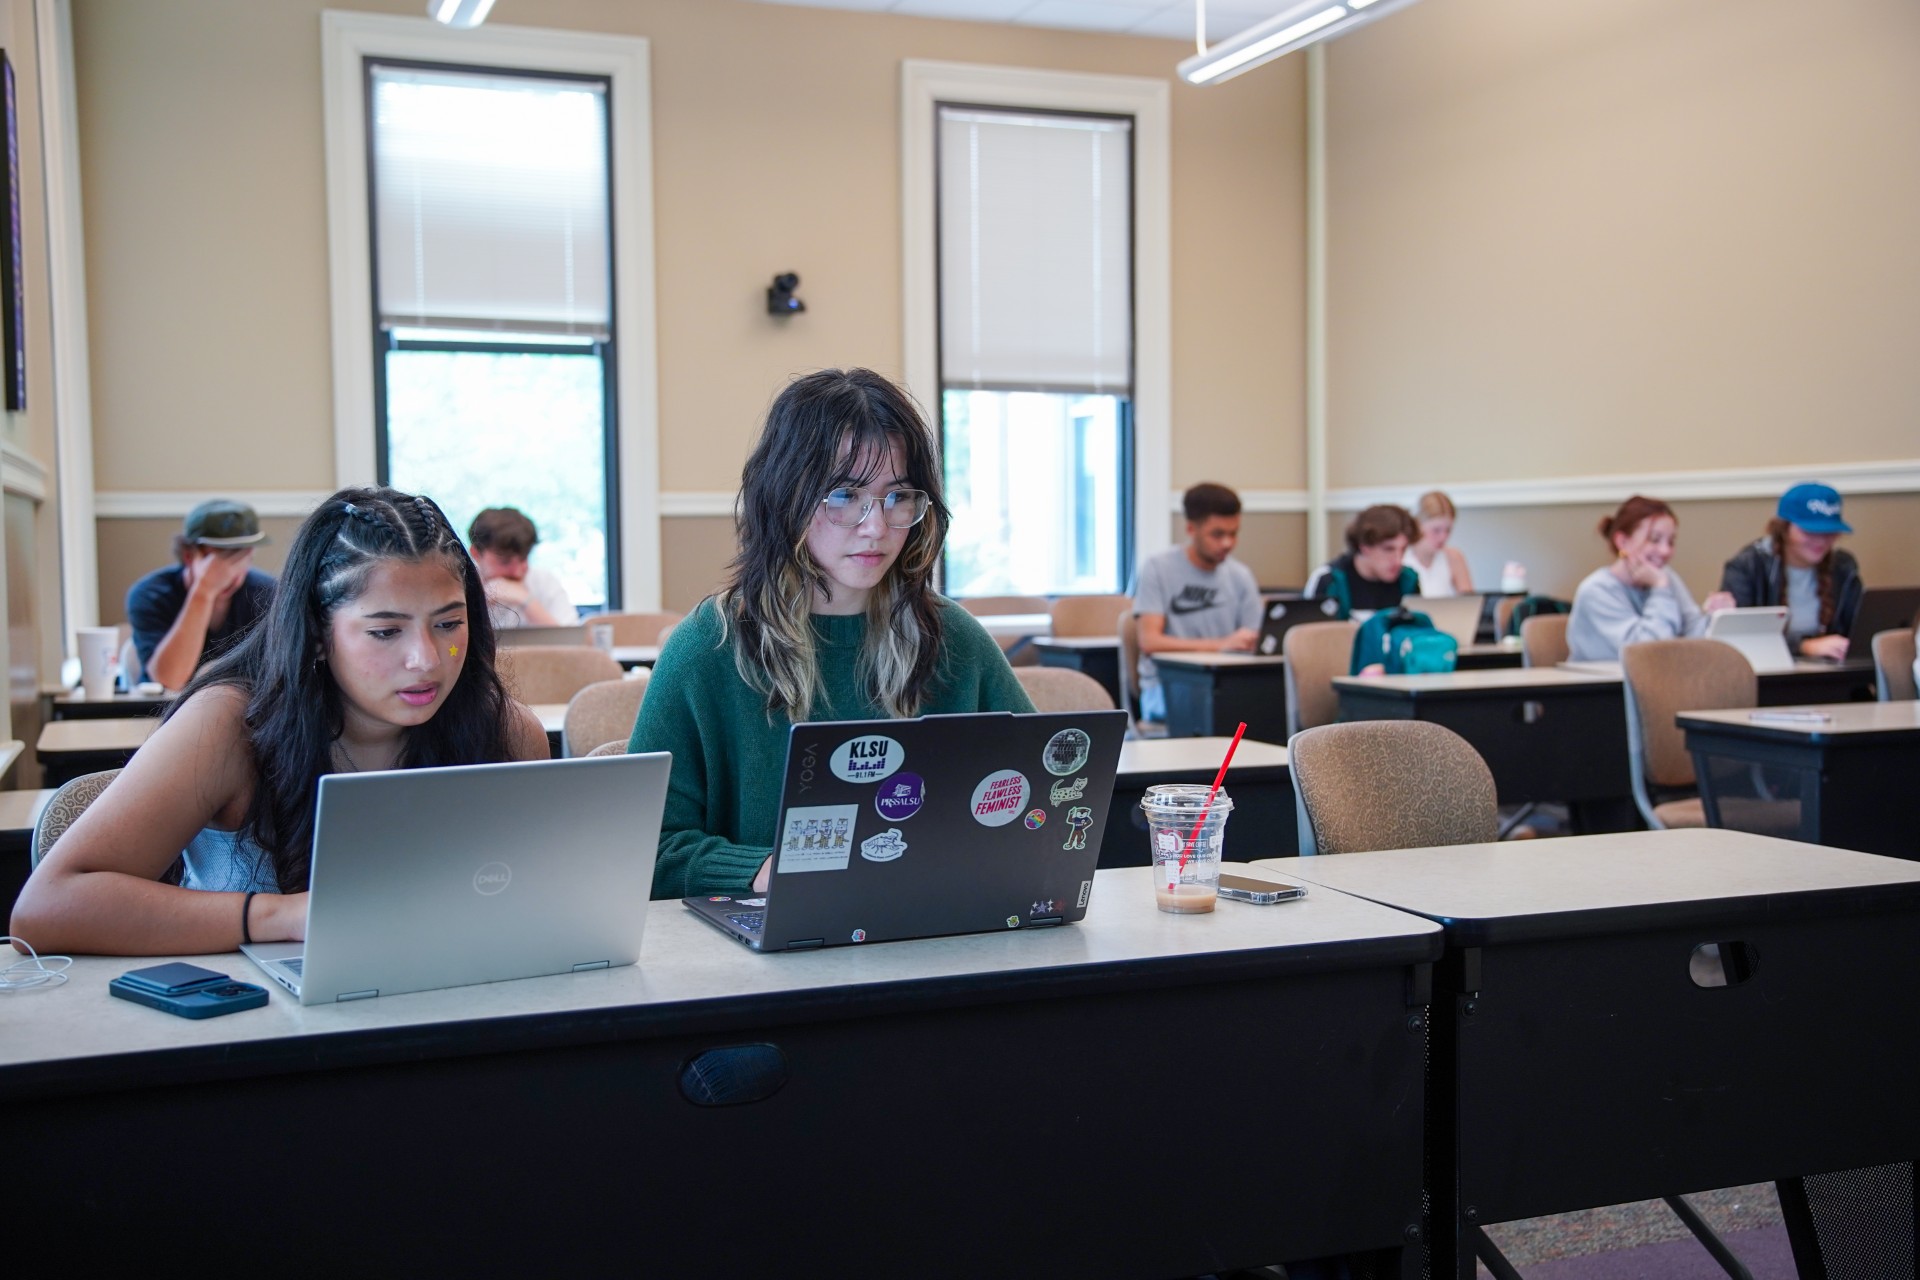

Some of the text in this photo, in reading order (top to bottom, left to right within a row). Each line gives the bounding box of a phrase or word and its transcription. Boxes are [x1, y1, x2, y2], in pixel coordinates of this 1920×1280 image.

[849, 740, 889, 759] KLSU
[799, 743, 818, 794] YOGA
[990, 775, 1022, 790] FEARLESS
[983, 785, 1023, 801] FLAWLESS
[974, 796, 1022, 815] FEMINIST
[478, 872, 507, 885] DELL
[1078, 882, 1089, 906] Lenovo
